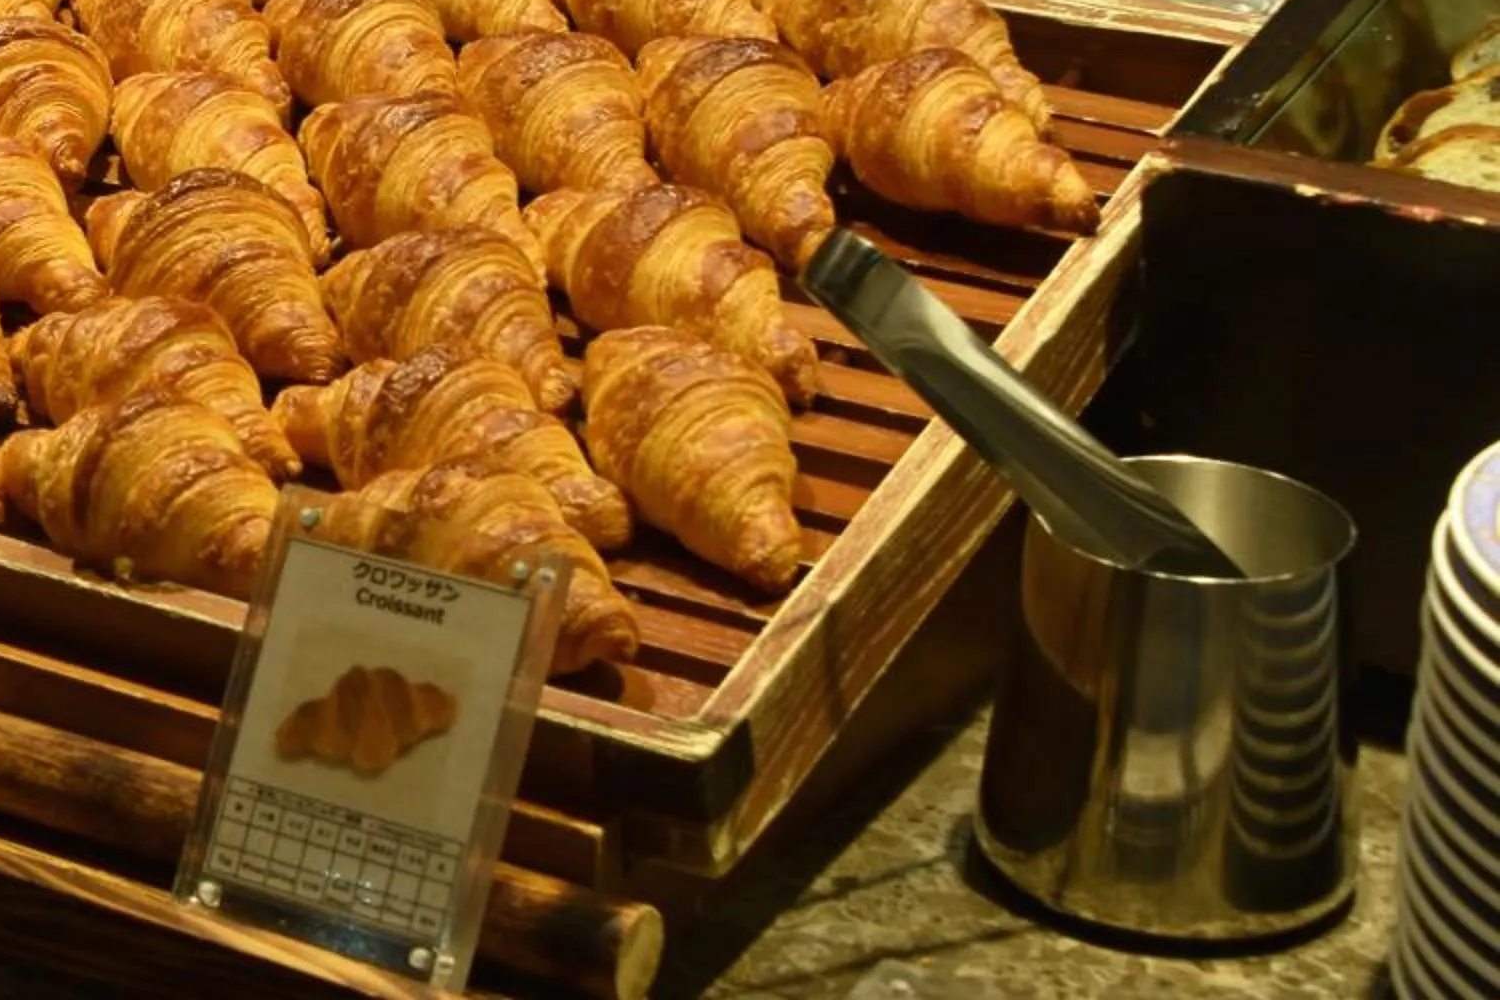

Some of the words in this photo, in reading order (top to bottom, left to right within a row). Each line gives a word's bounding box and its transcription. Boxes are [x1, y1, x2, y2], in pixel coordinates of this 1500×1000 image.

[353, 561, 461, 603] クロワッサン
[356, 587, 446, 627] Croissant
